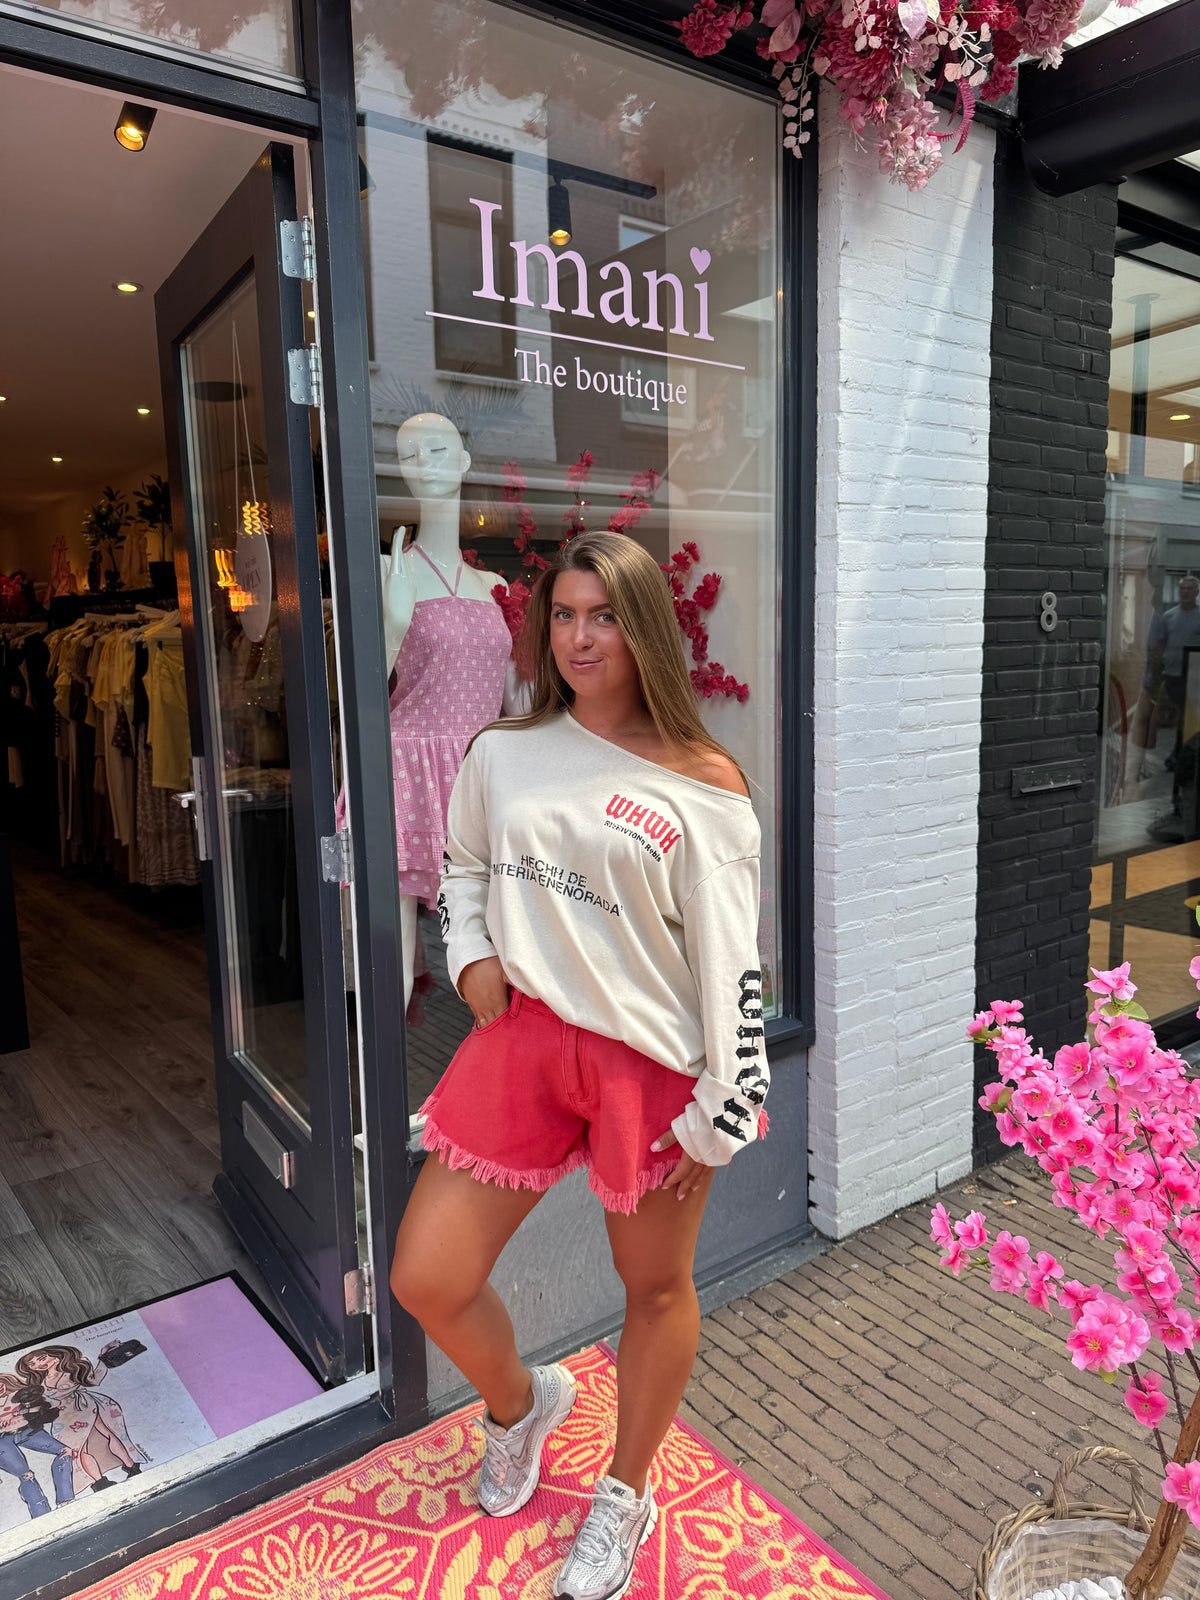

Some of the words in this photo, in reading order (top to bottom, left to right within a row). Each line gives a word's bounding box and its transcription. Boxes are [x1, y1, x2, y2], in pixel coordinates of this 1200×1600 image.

[469, 197, 715, 342] Imani
[514, 348, 567, 388] The
[574, 357, 688, 411] boutique
[1040, 591, 1058, 632] 8
[567, 871, 588, 888] DE
[610, 1485, 627, 1497] NIKE
